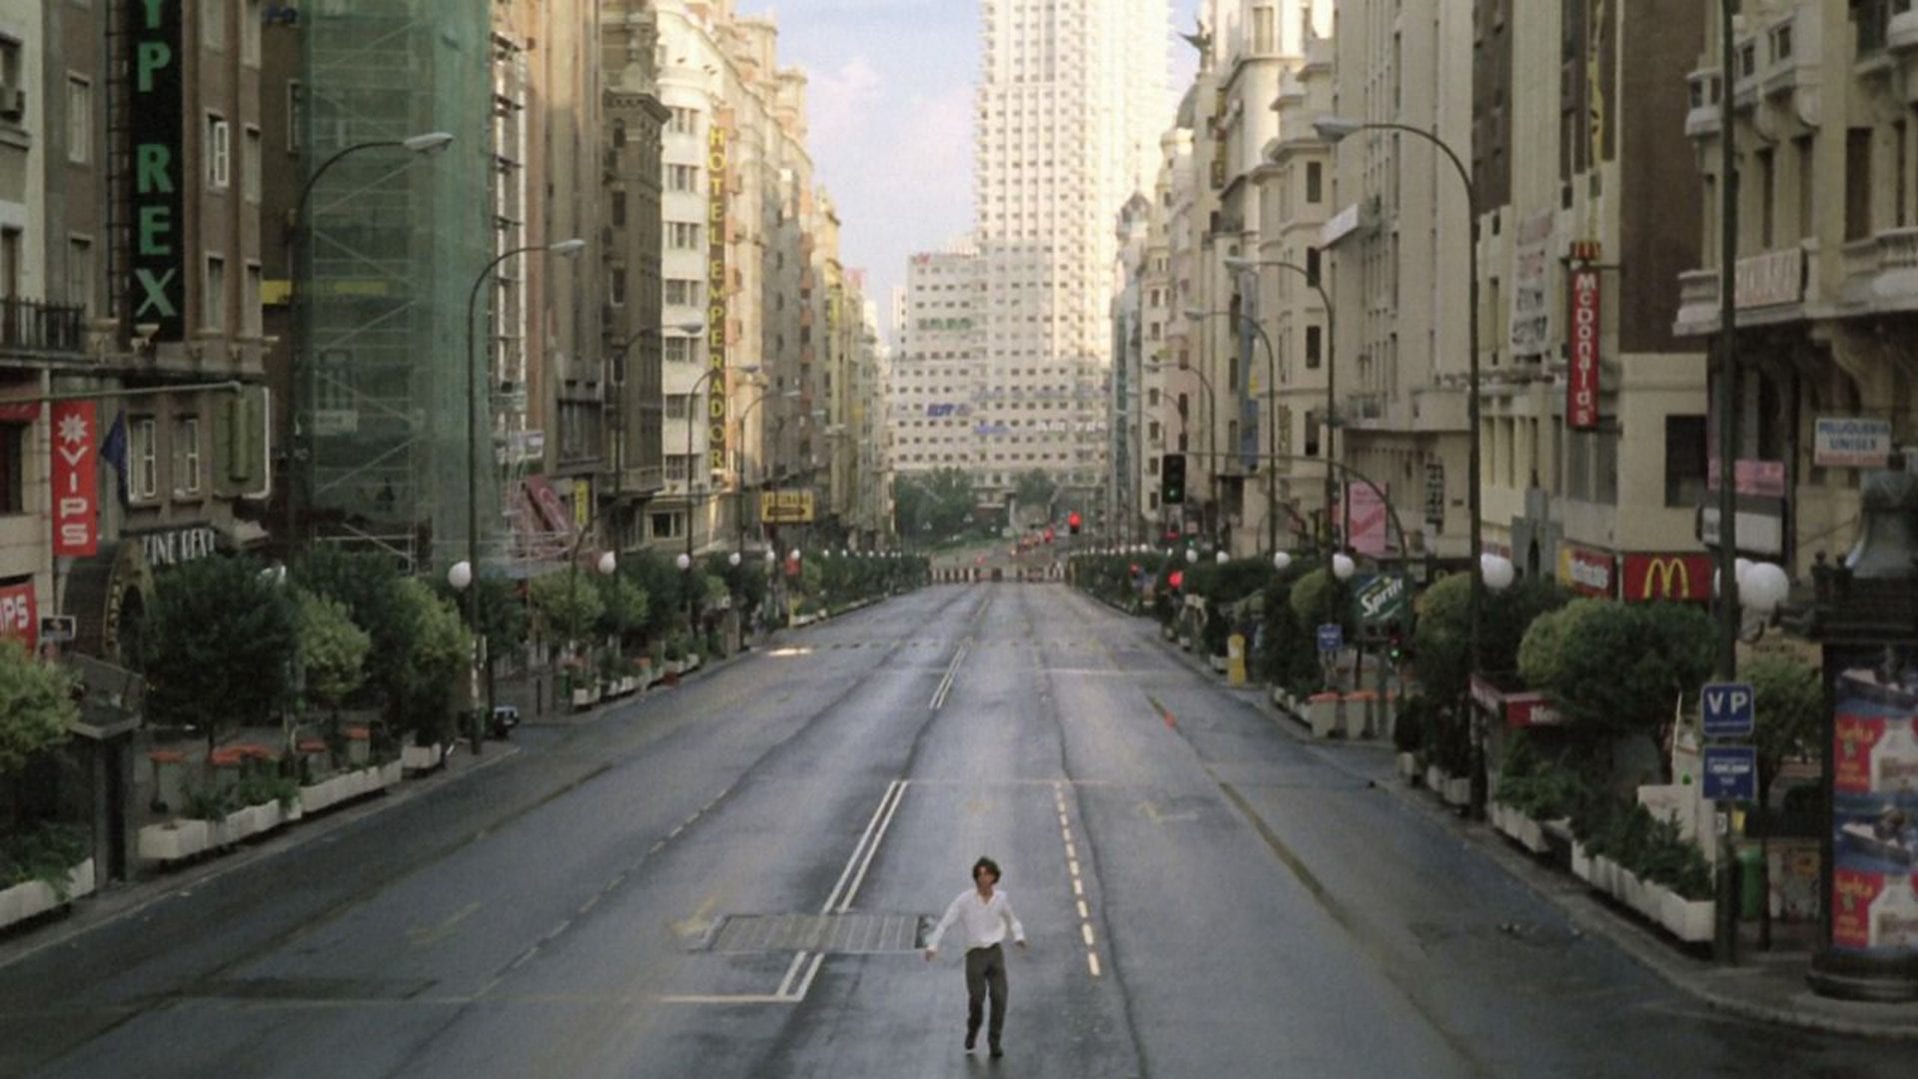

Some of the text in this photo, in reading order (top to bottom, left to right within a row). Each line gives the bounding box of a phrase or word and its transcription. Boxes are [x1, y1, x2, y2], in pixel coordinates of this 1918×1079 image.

[135, 143, 178, 318] REX
[708, 126, 727, 468] HOTEL EMPERADOR
[58, 445, 89, 546] VIPS
[1360, 577, 1404, 617] Sprite
